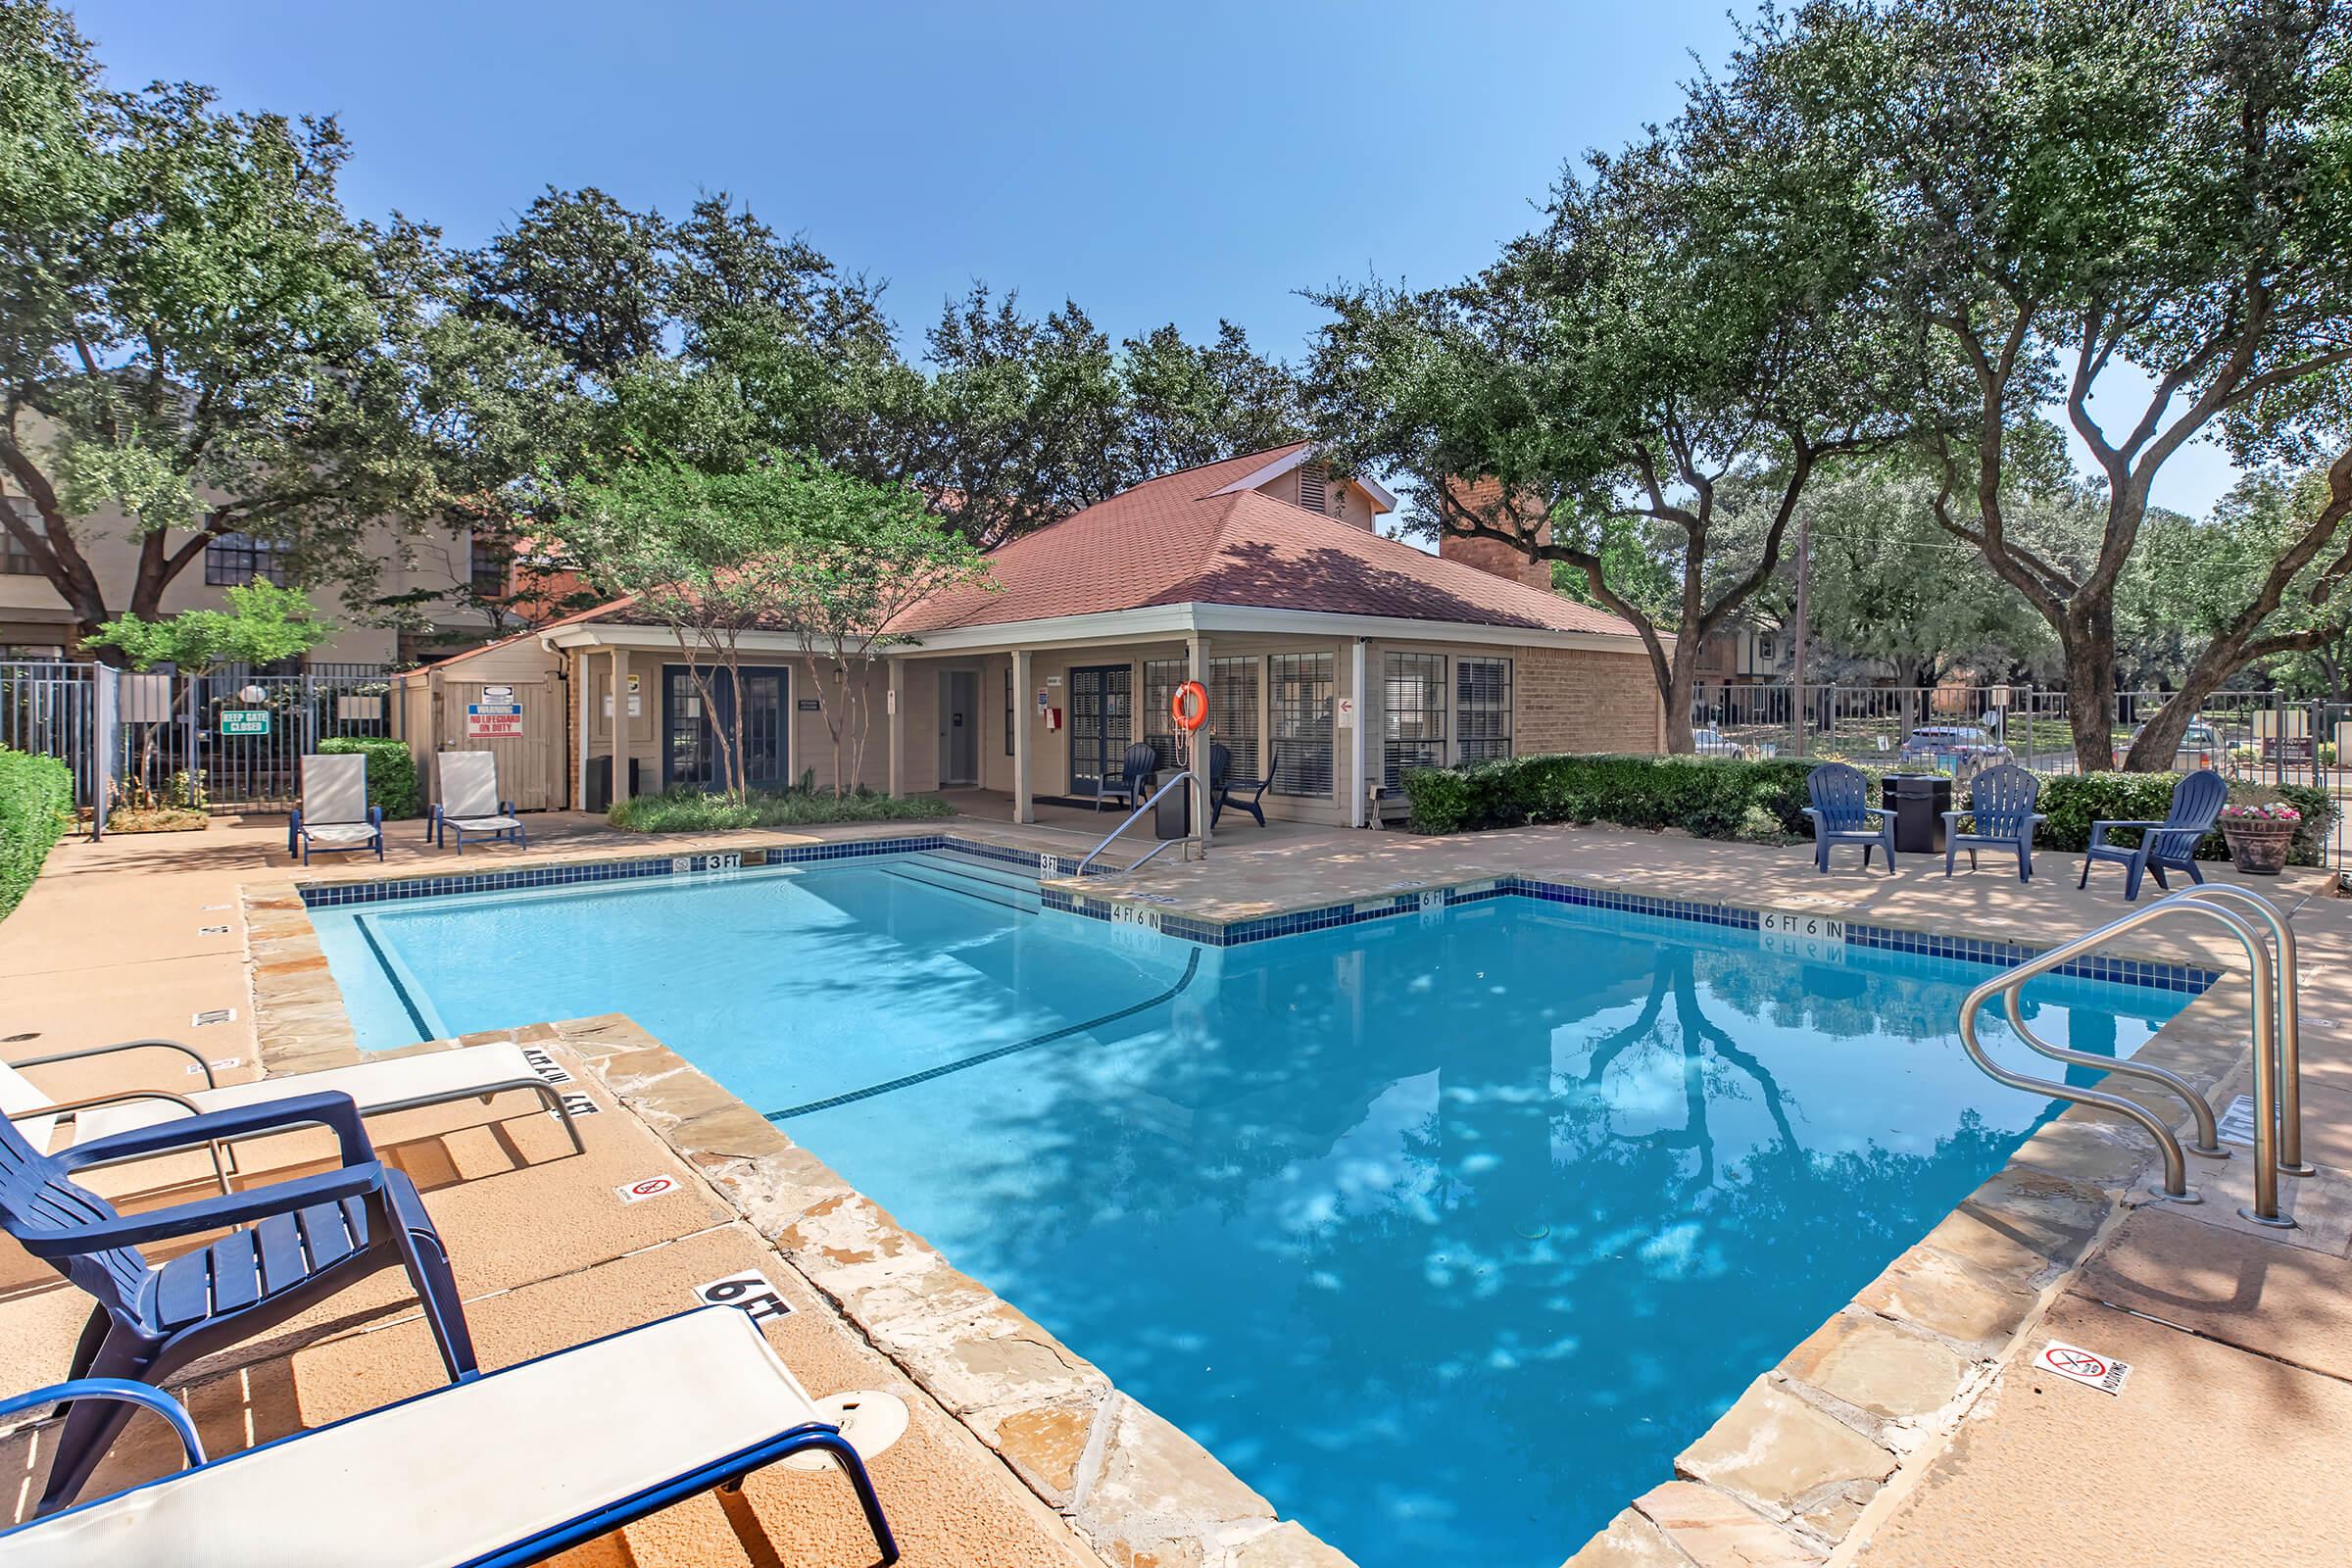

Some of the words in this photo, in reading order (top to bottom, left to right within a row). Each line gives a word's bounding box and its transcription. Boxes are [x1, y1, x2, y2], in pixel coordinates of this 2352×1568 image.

[222, 712, 244, 721] KEEP
[245, 712, 268, 721] GATE
[477, 705, 514, 714] WARNING
[469, 714, 481, 723] NO
[481, 714, 521, 723] LIFEGUARD
[230, 721, 263, 732] CLOSED
[478, 723, 491, 732] ON
[492, 723, 512, 732] DUTY
[710, 856, 721, 869] 3
[1042, 856, 1049, 869] 3
[1049, 857, 1056, 871] FT
[1423, 893, 1430, 906] 6
[1435, 891, 1443, 904] FT
[1113, 906, 1120, 919] 4
[1124, 907, 1134, 922] FT
[1137, 910, 1144, 925] 6
[1149, 912, 1158, 929] IN
[1765, 914, 1775, 928] 6
[1784, 916, 1797, 932] FT
[1806, 919, 1817, 934] 6
[1827, 921, 1841, 938] IN
[705, 1278, 766, 1302] 6
[733, 1292, 791, 1320] FT
[2105, 1361, 2128, 1383] DIVING
[2101, 1379, 2119, 1391] NO
